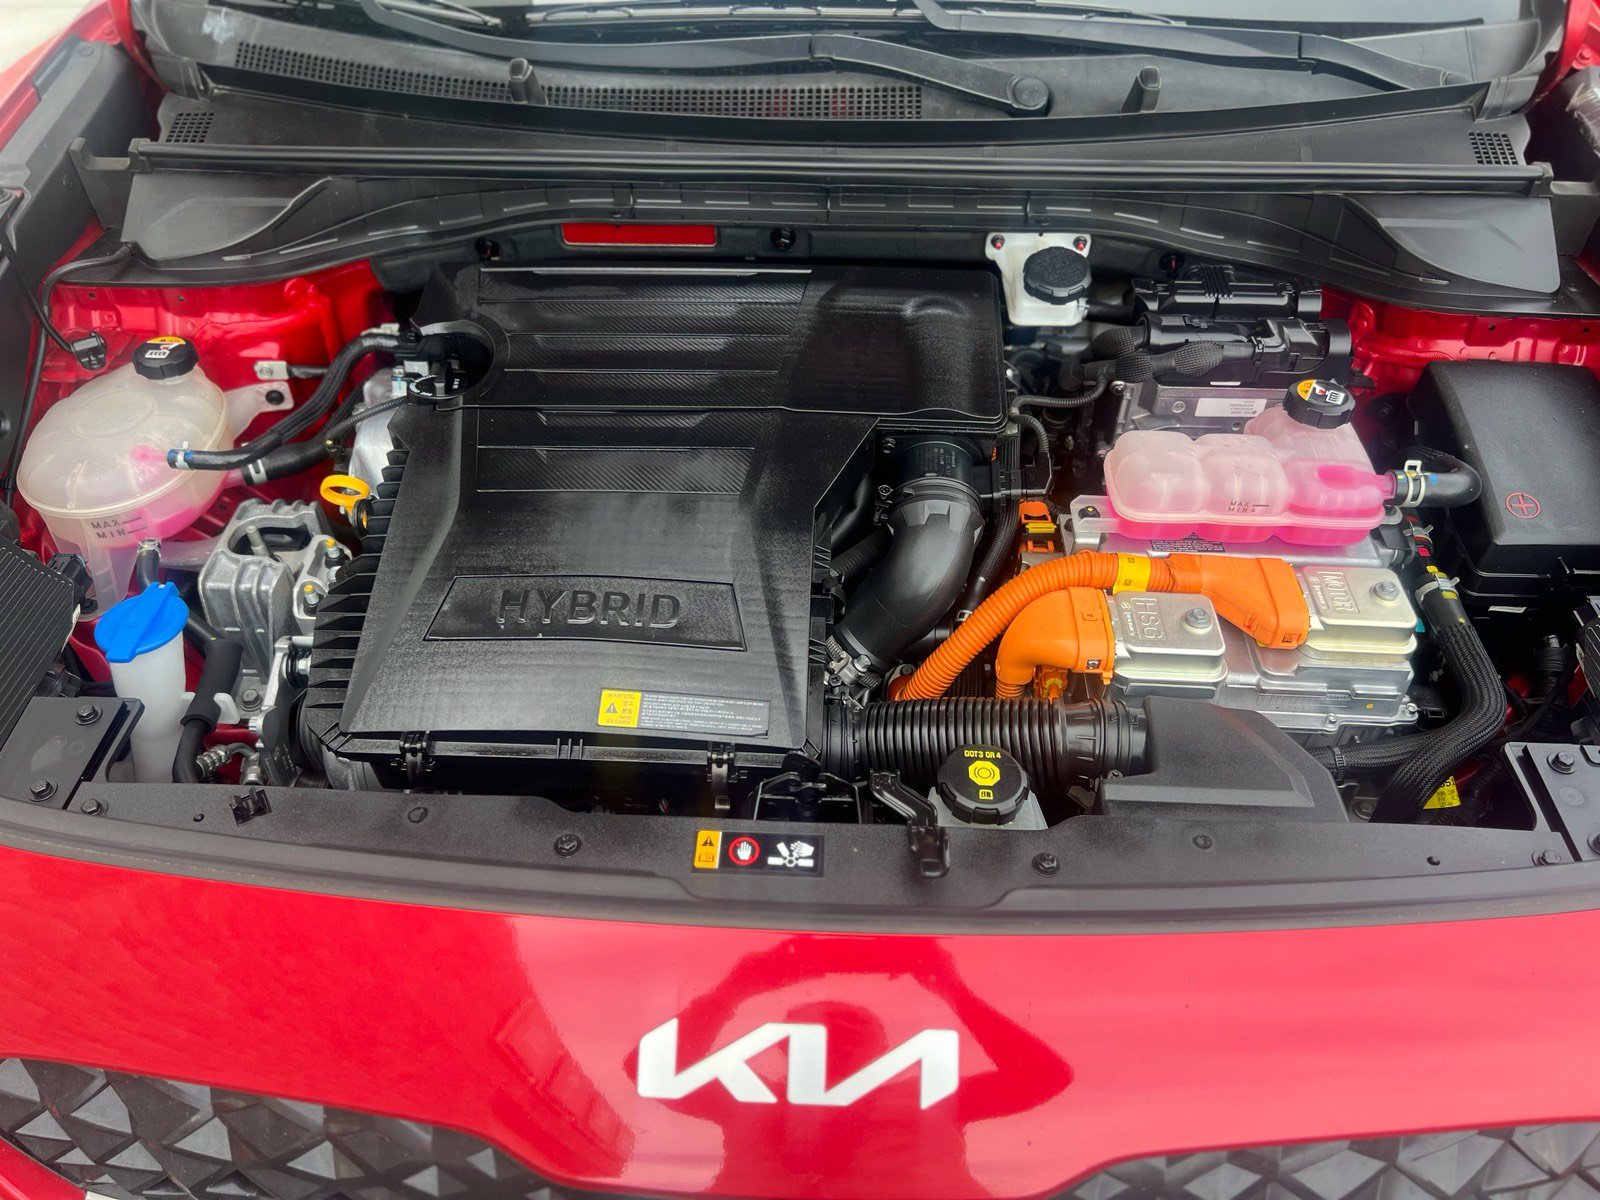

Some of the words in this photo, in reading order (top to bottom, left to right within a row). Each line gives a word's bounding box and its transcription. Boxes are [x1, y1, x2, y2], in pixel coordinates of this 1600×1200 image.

[91, 519, 120, 529] MAX
[96, 529, 126, 539] MIN
[495, 588, 682, 629] HYBRID
[1322, 575, 1355, 611] MOTOR
[1135, 602, 1163, 639] HSG
[964, 749, 984, 758] DOT3
[985, 751, 995, 759] OR
[637, 1017, 960, 1110] KIA
